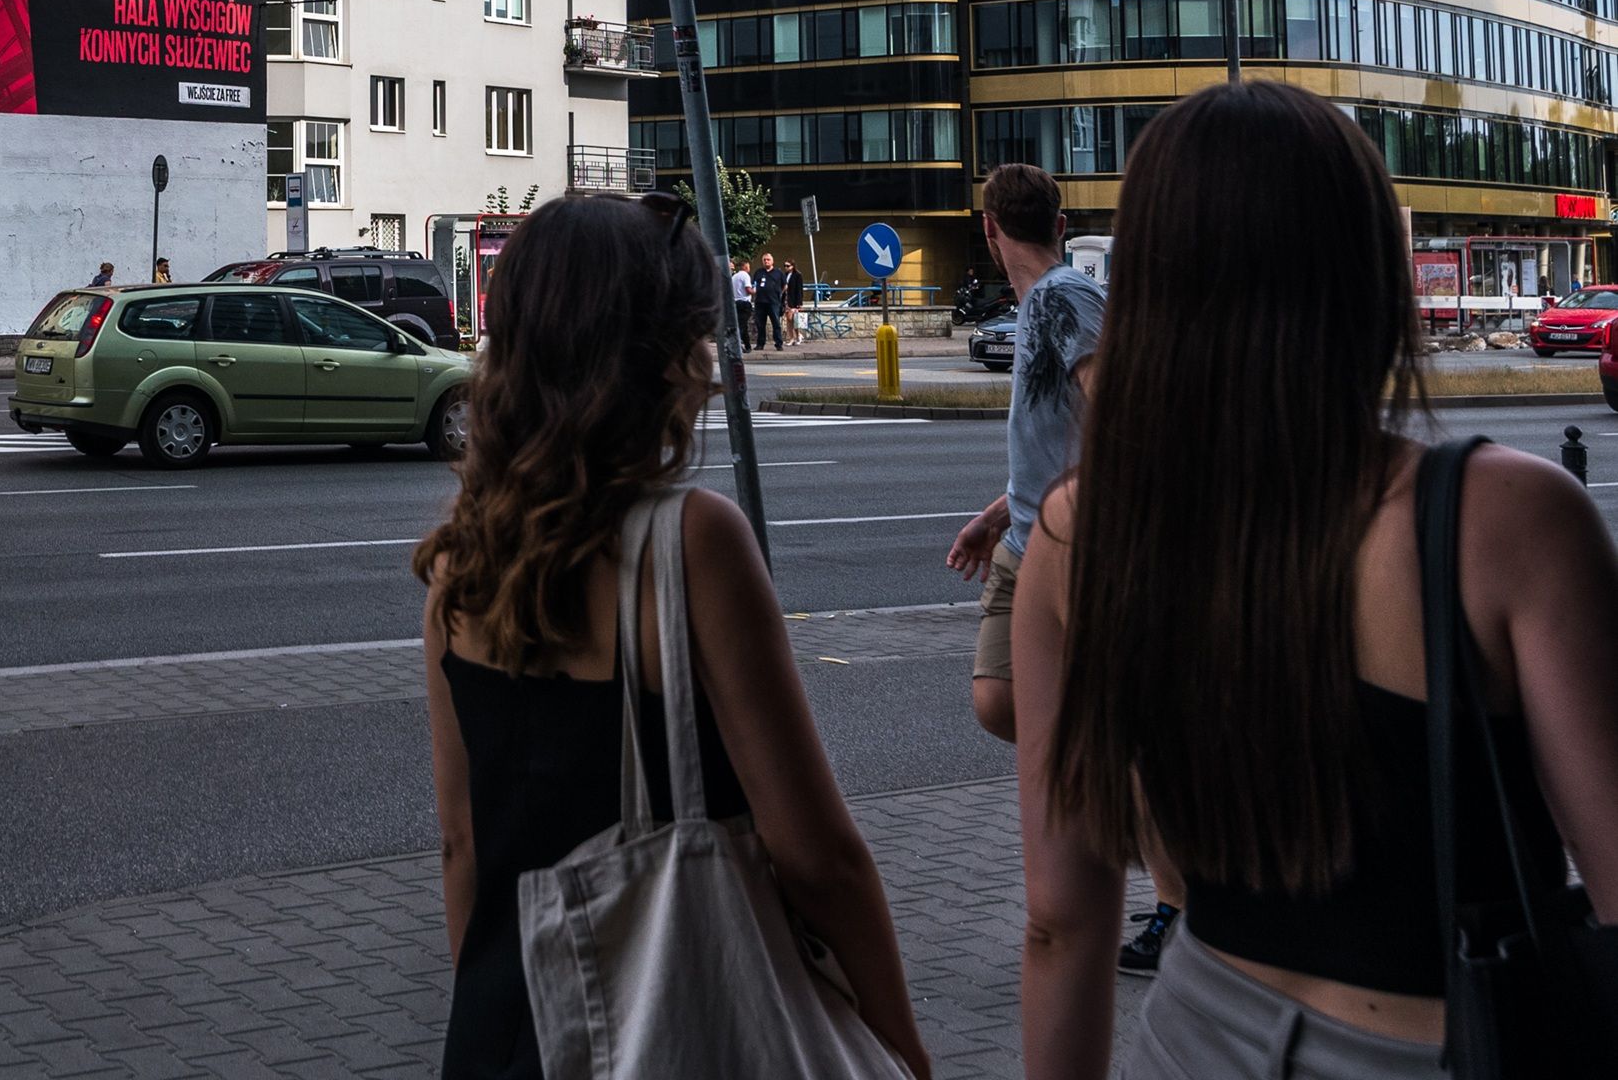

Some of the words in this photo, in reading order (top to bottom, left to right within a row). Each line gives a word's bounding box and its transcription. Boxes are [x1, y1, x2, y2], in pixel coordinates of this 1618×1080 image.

[79, 27, 161, 66] KONNYCH
[164, 32, 252, 74] SŁUŻEWIEC
[186, 84, 216, 101] WEJŚCIE
[216, 87, 225, 101] ZA
[225, 88, 241, 103] FREE
